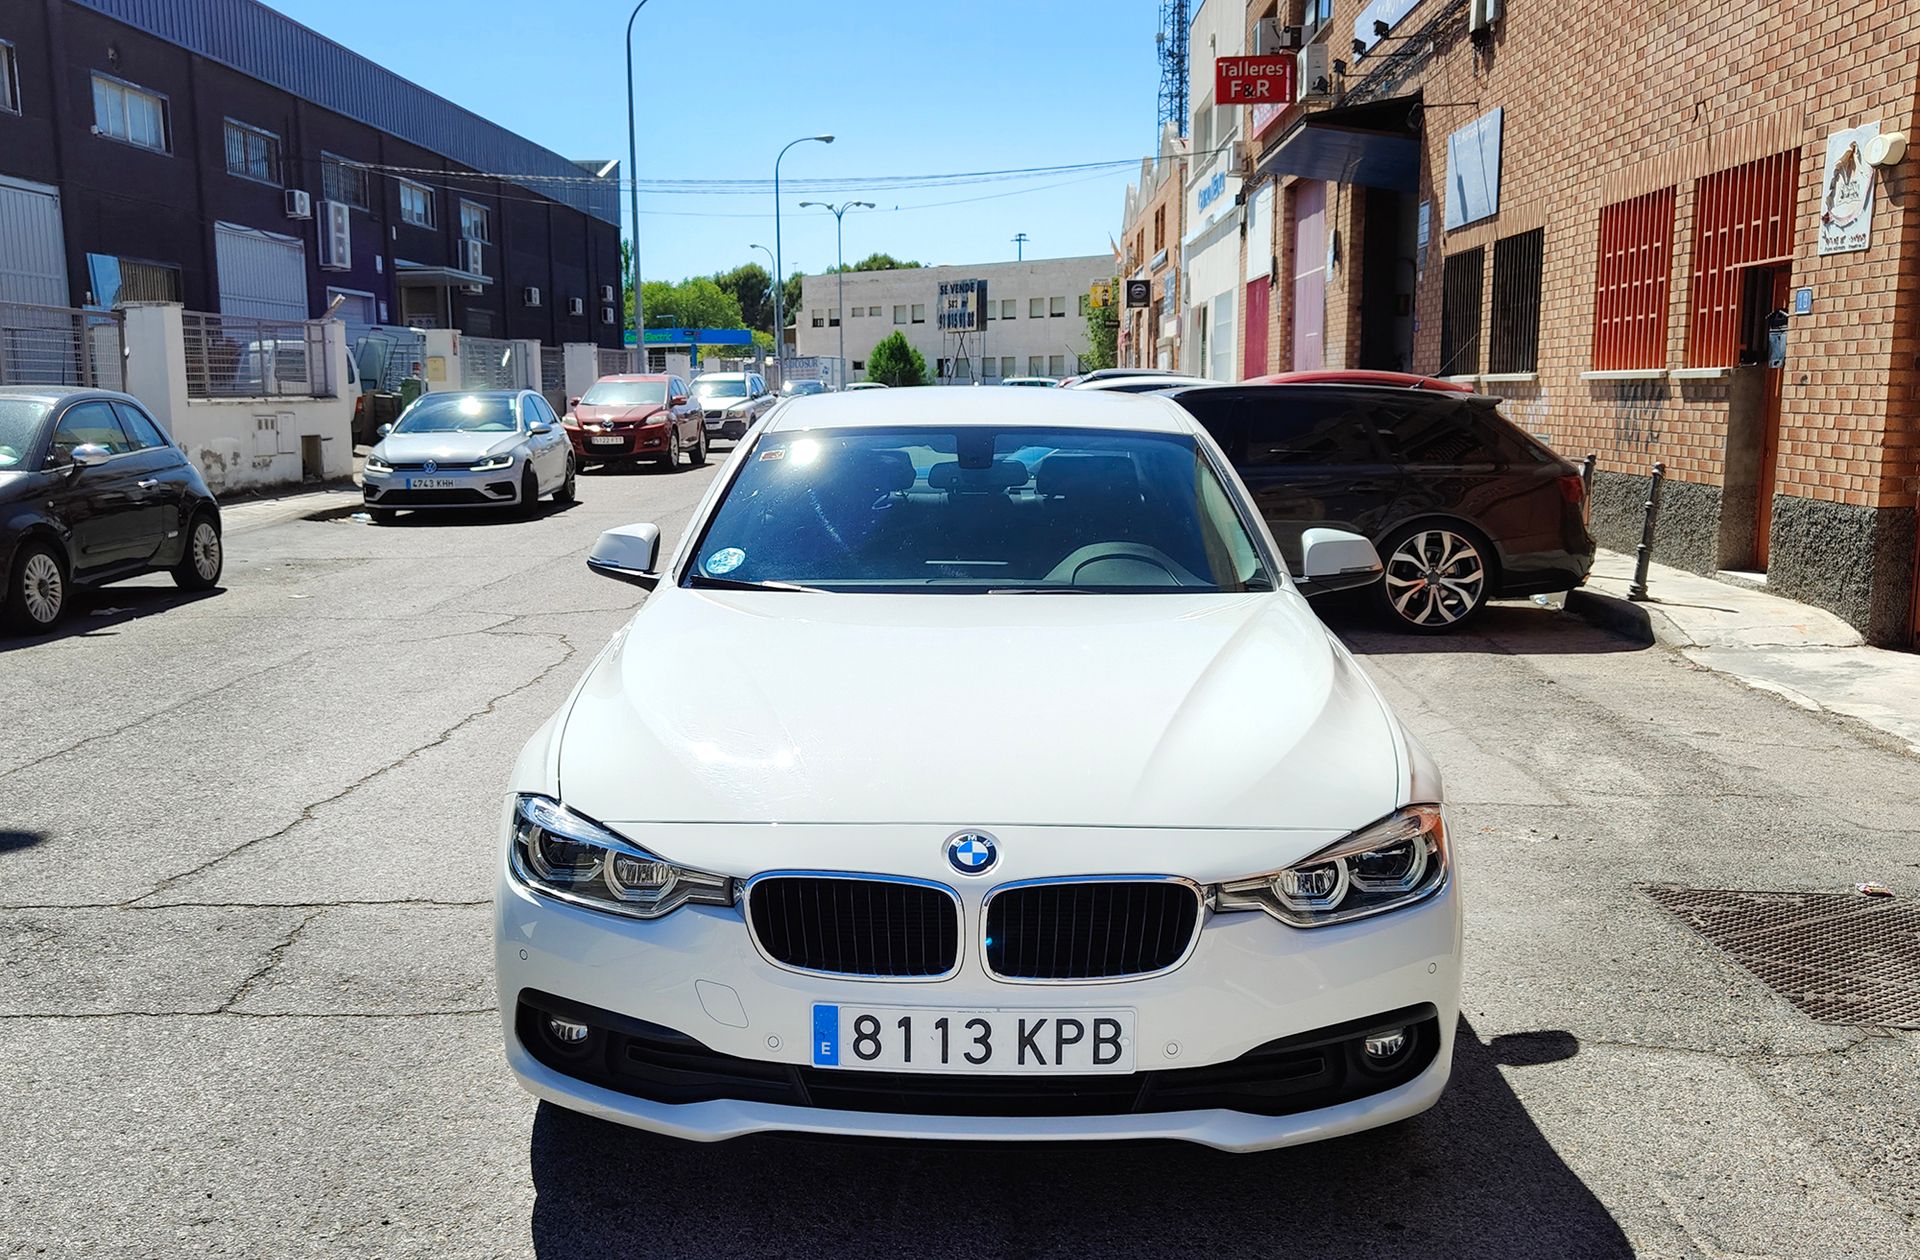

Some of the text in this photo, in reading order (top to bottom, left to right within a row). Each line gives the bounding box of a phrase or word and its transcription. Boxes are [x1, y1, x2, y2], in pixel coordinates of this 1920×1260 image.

[1220, 61, 1284, 77] Talleres
[1231, 80, 1270, 98] F&R
[940, 282, 975, 295] SE VENDE
[412, 479, 434, 488] 4743
[852, 1014, 1123, 1066] 8113 KPB
[821, 1042, 830, 1055] E
